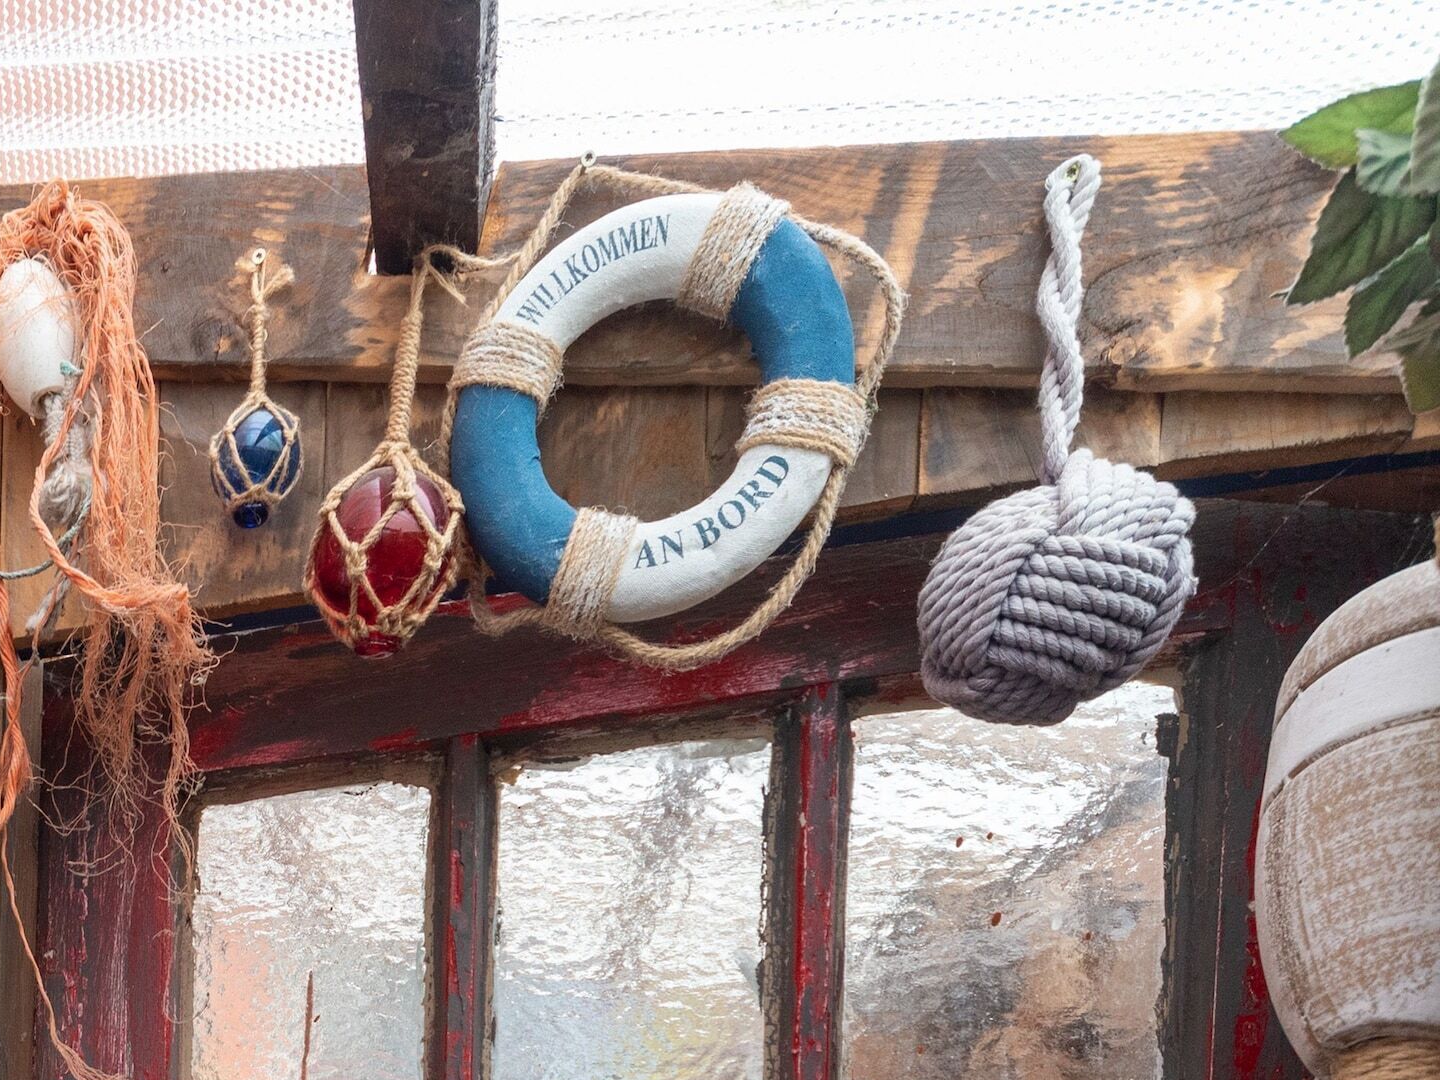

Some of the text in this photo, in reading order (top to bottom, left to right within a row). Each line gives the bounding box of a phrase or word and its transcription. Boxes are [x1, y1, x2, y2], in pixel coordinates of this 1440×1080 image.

[516, 214, 671, 326] WILLKOMMEN
[634, 455, 790, 569] AN BORD
